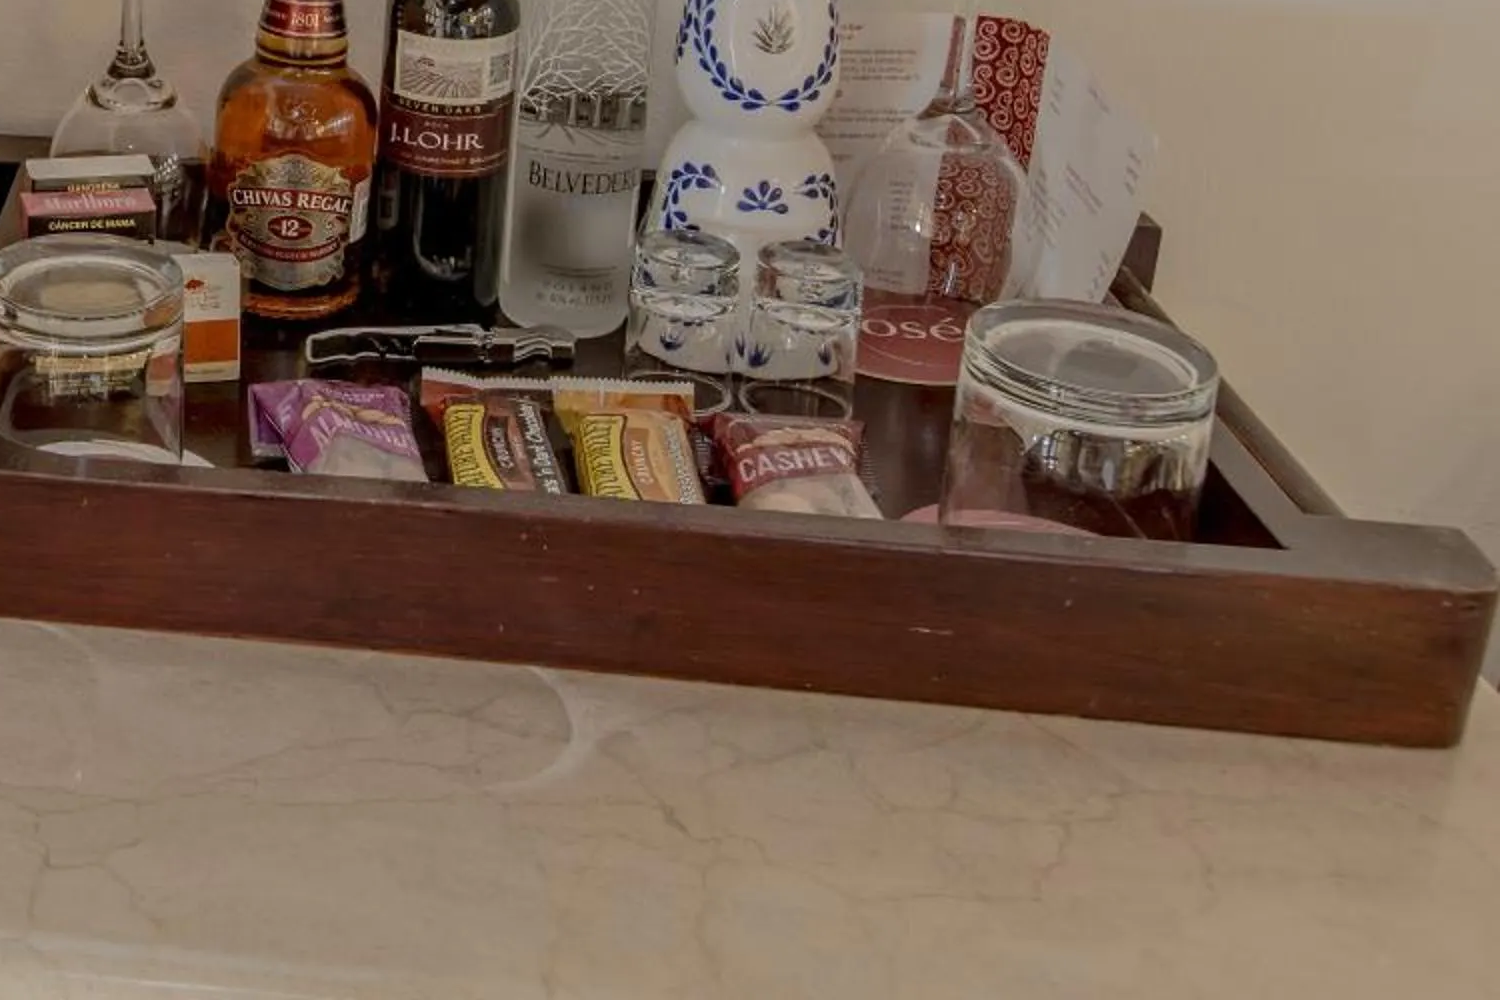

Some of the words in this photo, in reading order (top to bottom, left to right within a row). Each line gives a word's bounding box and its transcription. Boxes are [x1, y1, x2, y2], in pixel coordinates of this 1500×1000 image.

[291, 12, 320, 28] 1801
[233, 189, 292, 207] CHIVAS
[297, 191, 350, 214] REGAL
[279, 219, 300, 238] 12
